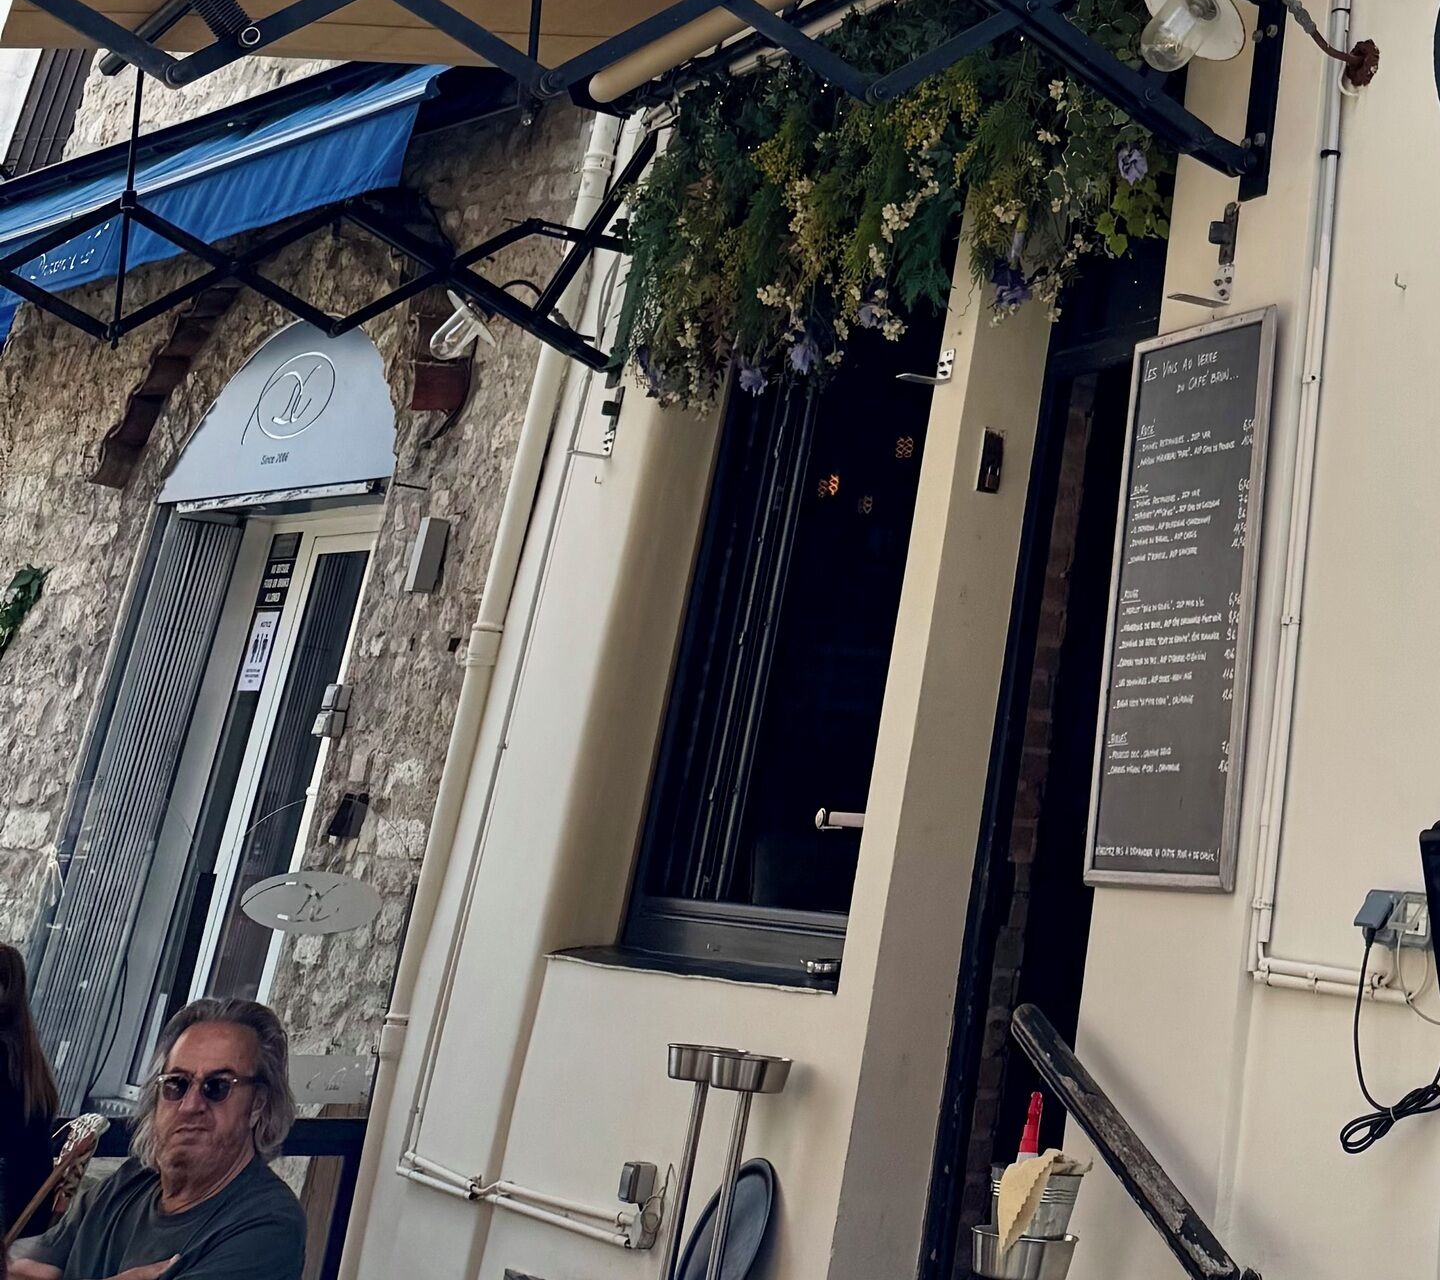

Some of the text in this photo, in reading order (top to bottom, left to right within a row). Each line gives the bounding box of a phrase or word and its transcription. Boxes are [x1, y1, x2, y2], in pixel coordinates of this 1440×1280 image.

[1144, 360, 1157, 383] LES
[1197, 351, 1218, 367] VERRE
[1189, 370, 1209, 391] CAFÉ
